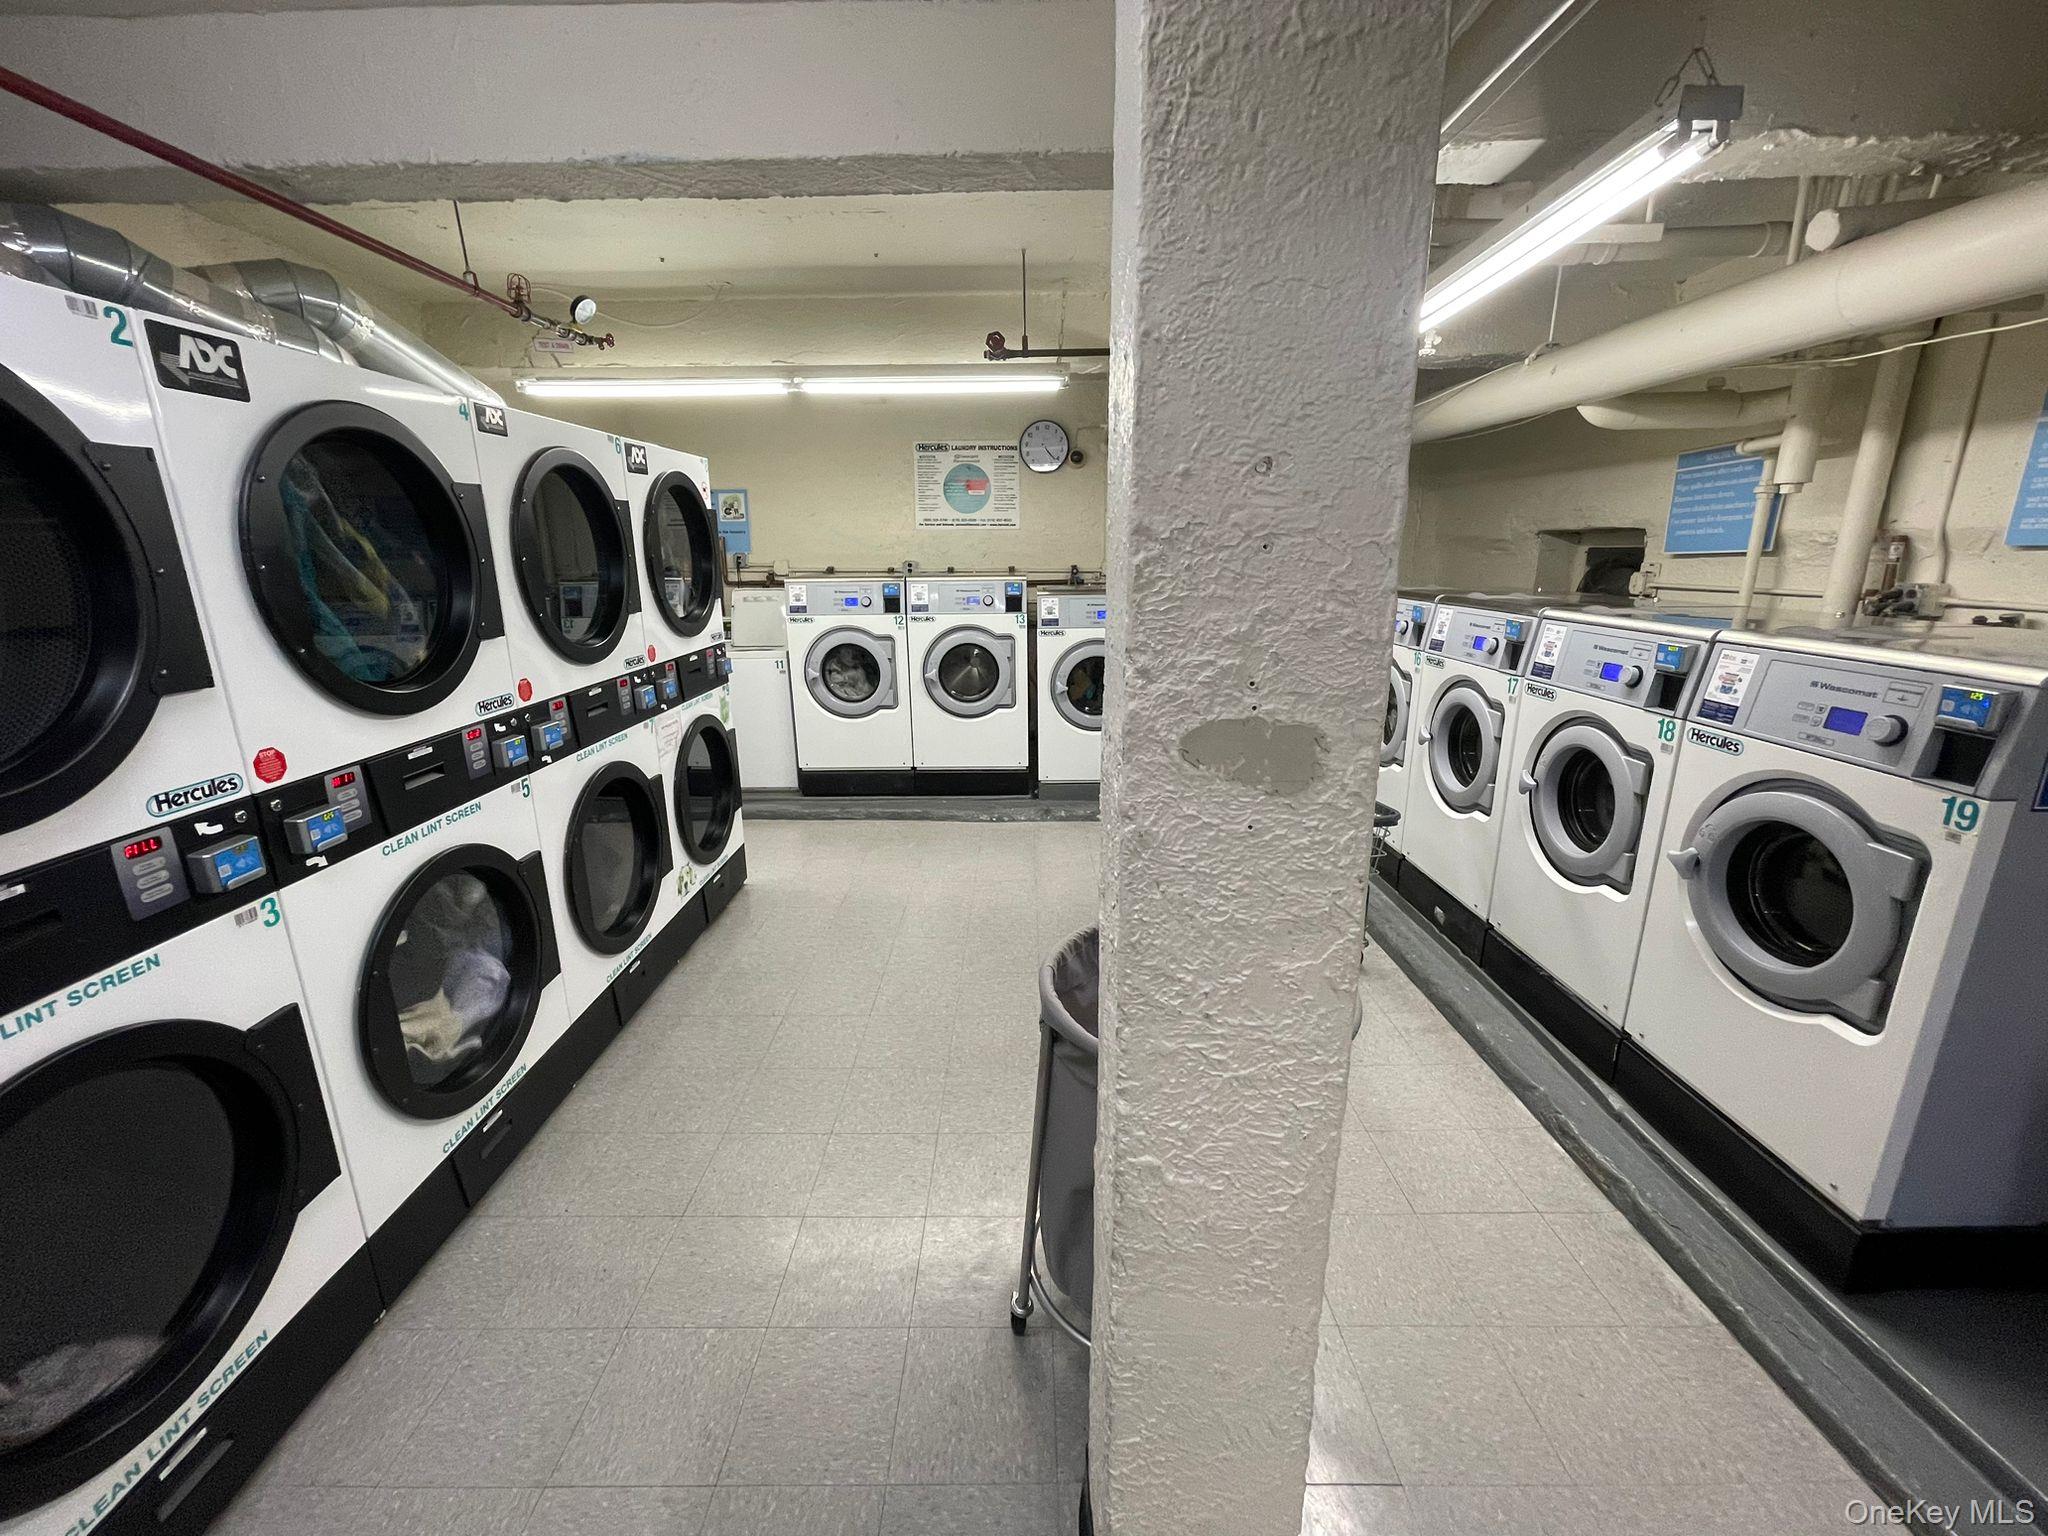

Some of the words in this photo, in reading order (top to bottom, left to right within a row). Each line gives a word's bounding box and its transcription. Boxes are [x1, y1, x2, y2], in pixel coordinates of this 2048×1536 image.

[103, 306, 133, 347] 2
[180, 334, 237, 379] ADC
[459, 404, 469, 421] 4
[615, 437, 621, 454] 6
[893, 616, 904, 625] 12
[1015, 615, 1025, 624] 13
[774, 660, 784, 669] 11
[1414, 652, 1421, 666] 16
[1508, 677, 1519, 695] 17
[1527, 683, 1555, 699] Hercules
[1820, 682, 1879, 699] Wascomat
[479, 696, 512, 714] Hercules
[1657, 718, 1676, 742] 18
[1691, 728, 1740, 753] Hercules
[576, 748, 595, 762] CLEAN
[154, 777, 238, 812] Hercules
[521, 777, 531, 798] 5
[1941, 796, 1980, 832] 19
[382, 831, 419, 857] CLEAN
[421, 819, 443, 838] LINT
[445, 802, 482, 826] SCREEN
[260, 898, 280, 928] 3
[0, 1000, 58, 1040] LINT
[67, 953, 161, 1007] SCREEN
[442, 1117, 474, 1154] CLEAN
[475, 1096, 494, 1120] LINT
[495, 1063, 527, 1099] SCREEN
[65, 1462, 142, 1536] CLEAN
[146, 1408, 191, 1461] LINT
[197, 1329, 268, 1409] SCREEN
